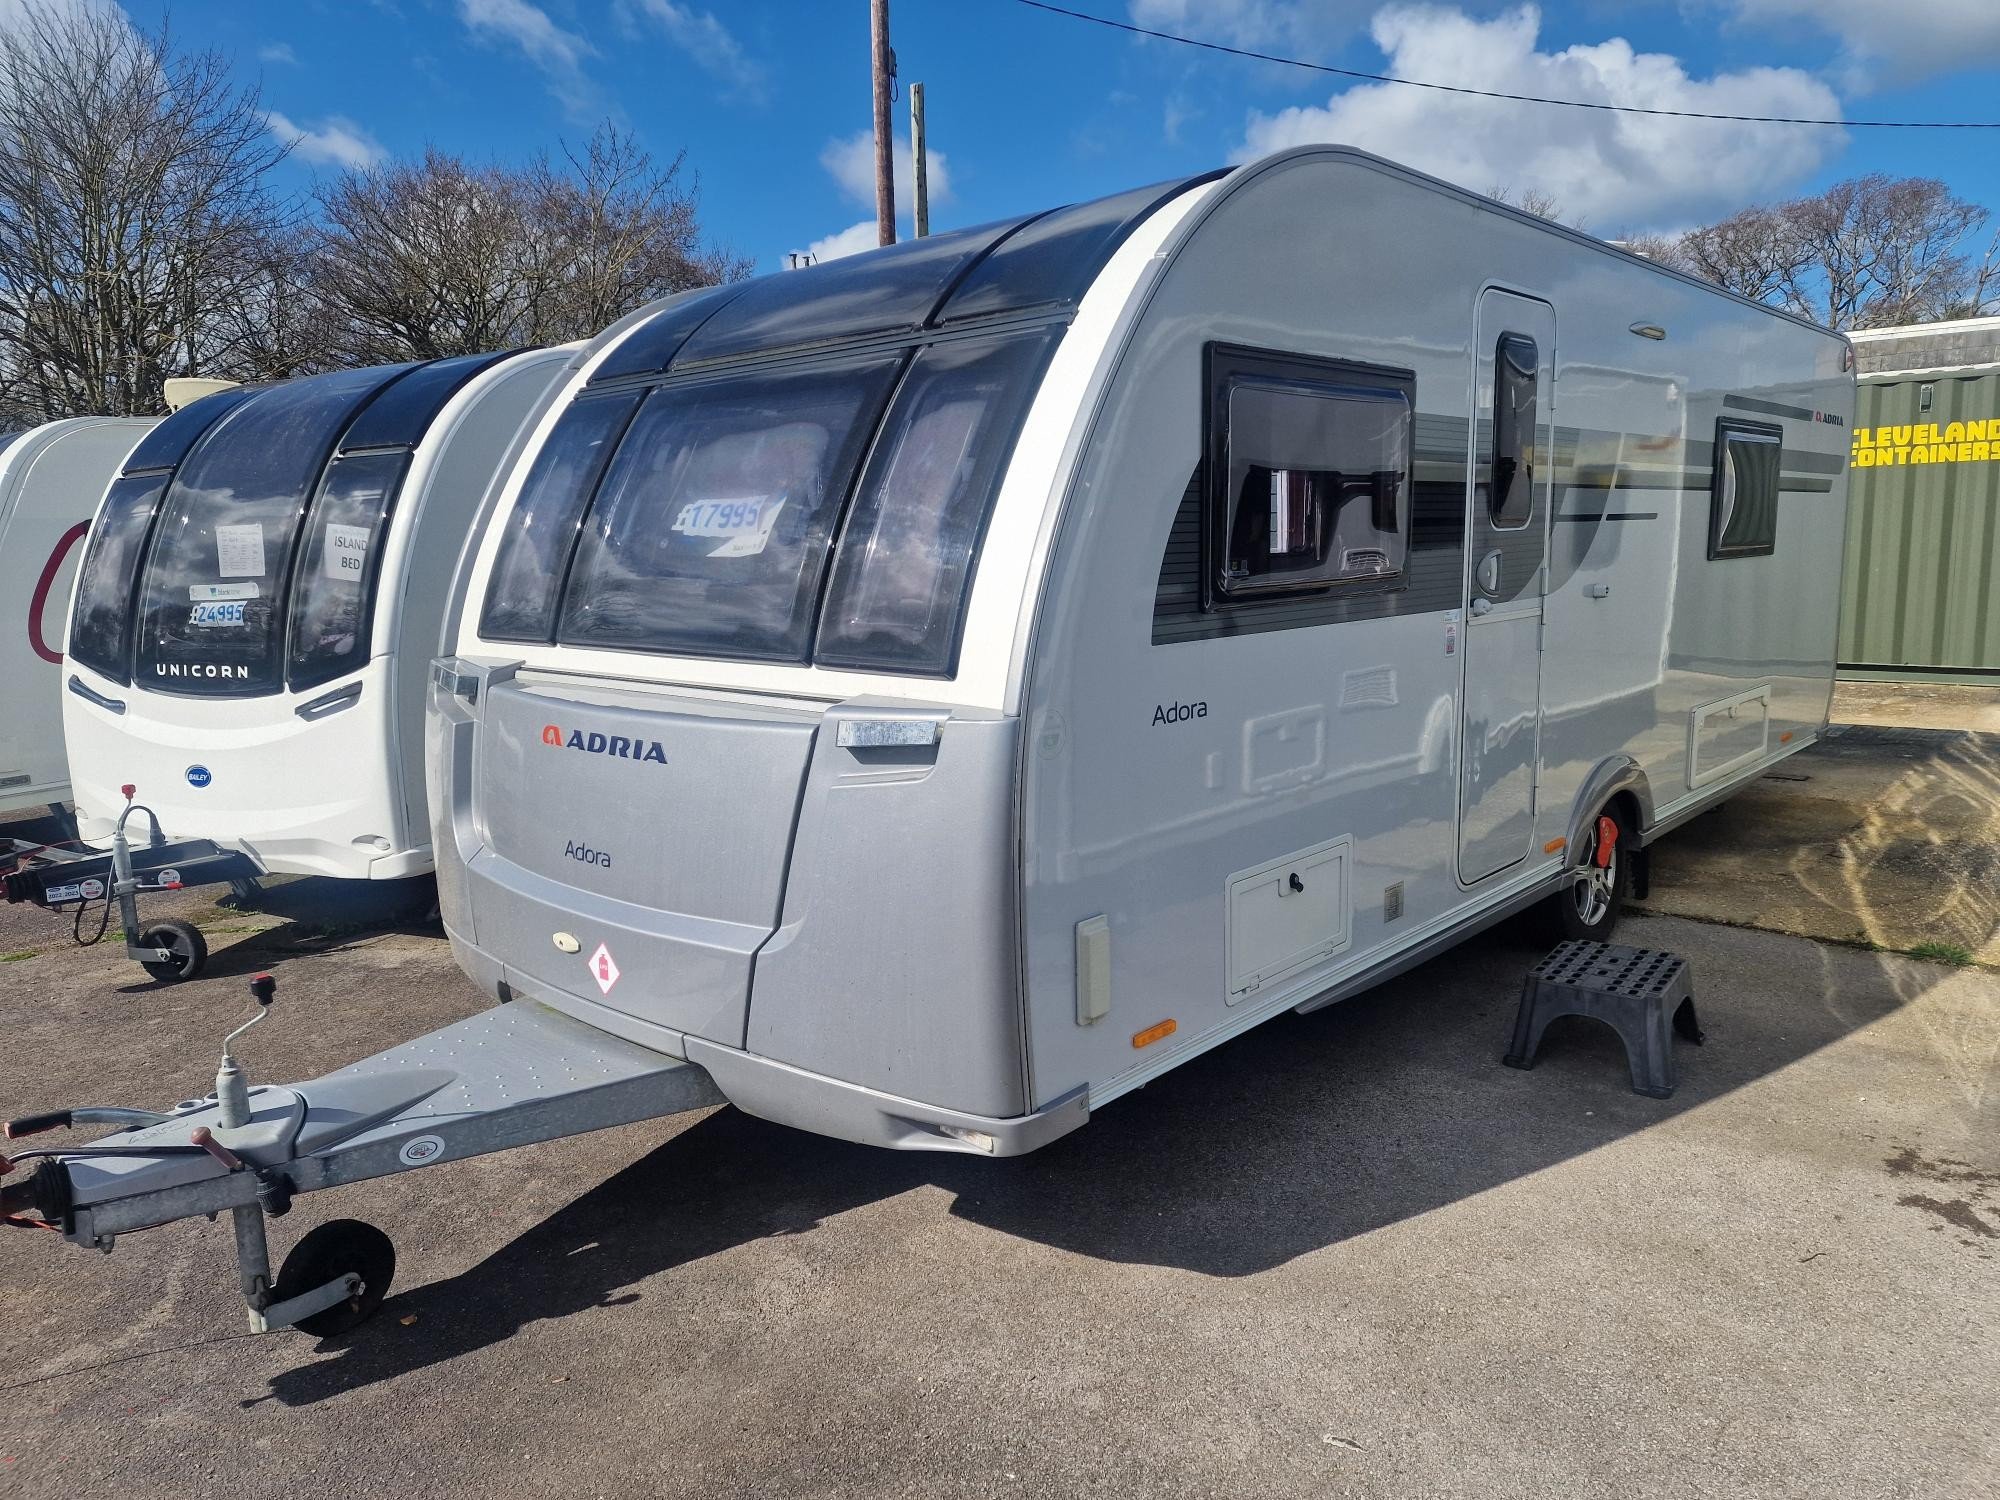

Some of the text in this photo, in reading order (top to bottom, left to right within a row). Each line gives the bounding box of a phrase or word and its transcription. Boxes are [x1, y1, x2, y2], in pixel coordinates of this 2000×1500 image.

[1823, 411, 1844, 427] ADRIA
[334, 535, 369, 551] ISLAND
[341, 556, 361, 570] BED
[156, 663, 248, 679] UNICORN
[1152, 701, 1208, 727] Adora
[566, 729, 669, 765] ADRIA
[188, 773, 208, 781] BAILEY
[564, 839, 612, 869] Adora
